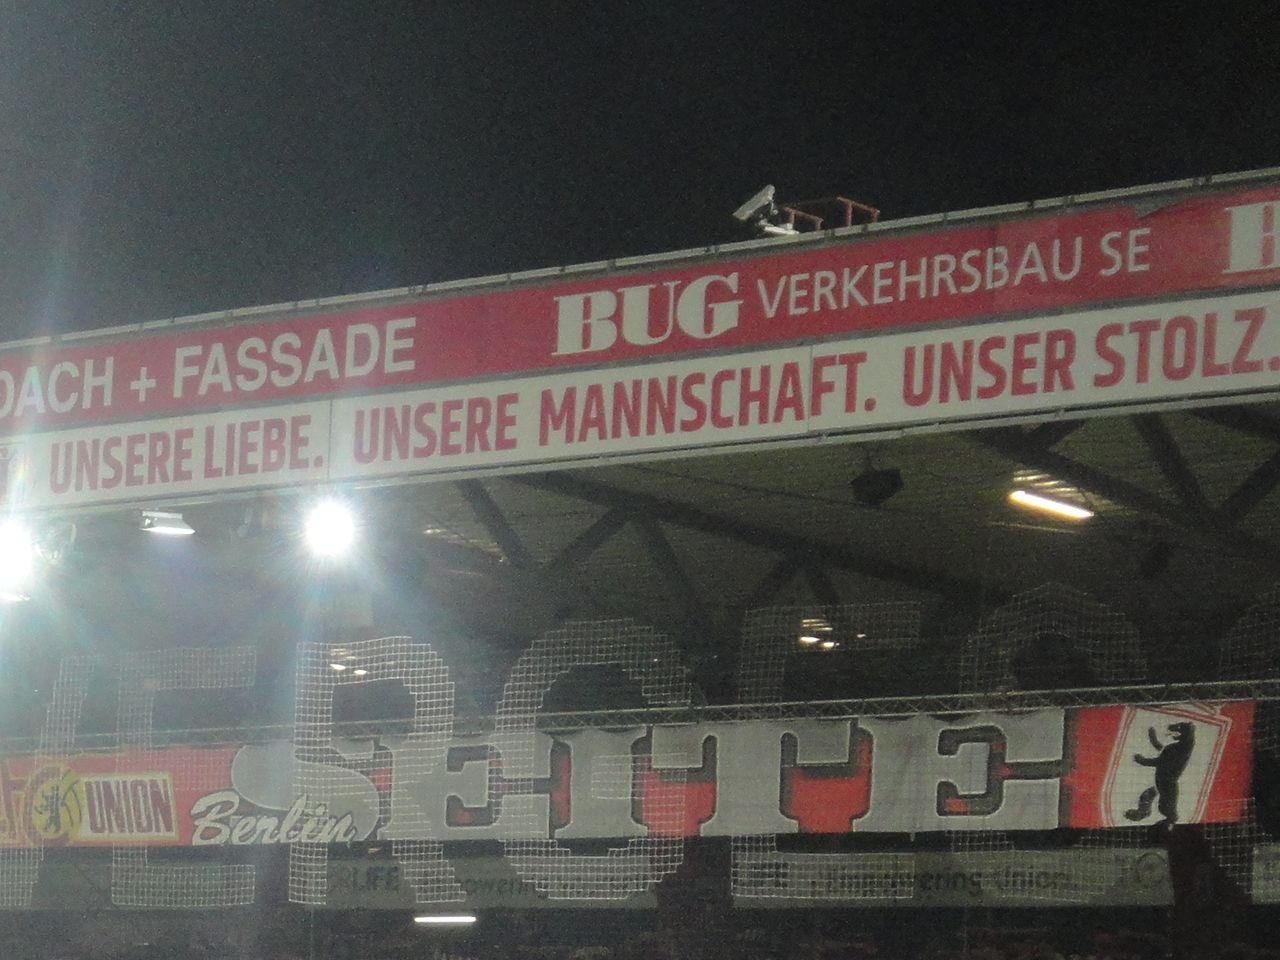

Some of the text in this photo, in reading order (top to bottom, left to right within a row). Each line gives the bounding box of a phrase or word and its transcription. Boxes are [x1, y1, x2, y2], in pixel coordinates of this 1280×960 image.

[551, 226, 1152, 357] BUG VERKEHRSBAU SE
[130, 366, 156, 403] +
[173, 316, 418, 400] FASSADE
[50, 426, 194, 496] UNSERE
[203, 414, 324, 480] LIEBE.
[352, 391, 520, 466] UNSERE
[538, 351, 877, 447] MANNSCHAFT.
[902, 328, 1076, 408] UNSER
[83, 778, 175, 834] UNION
[190, 790, 360, 848] Berlin
